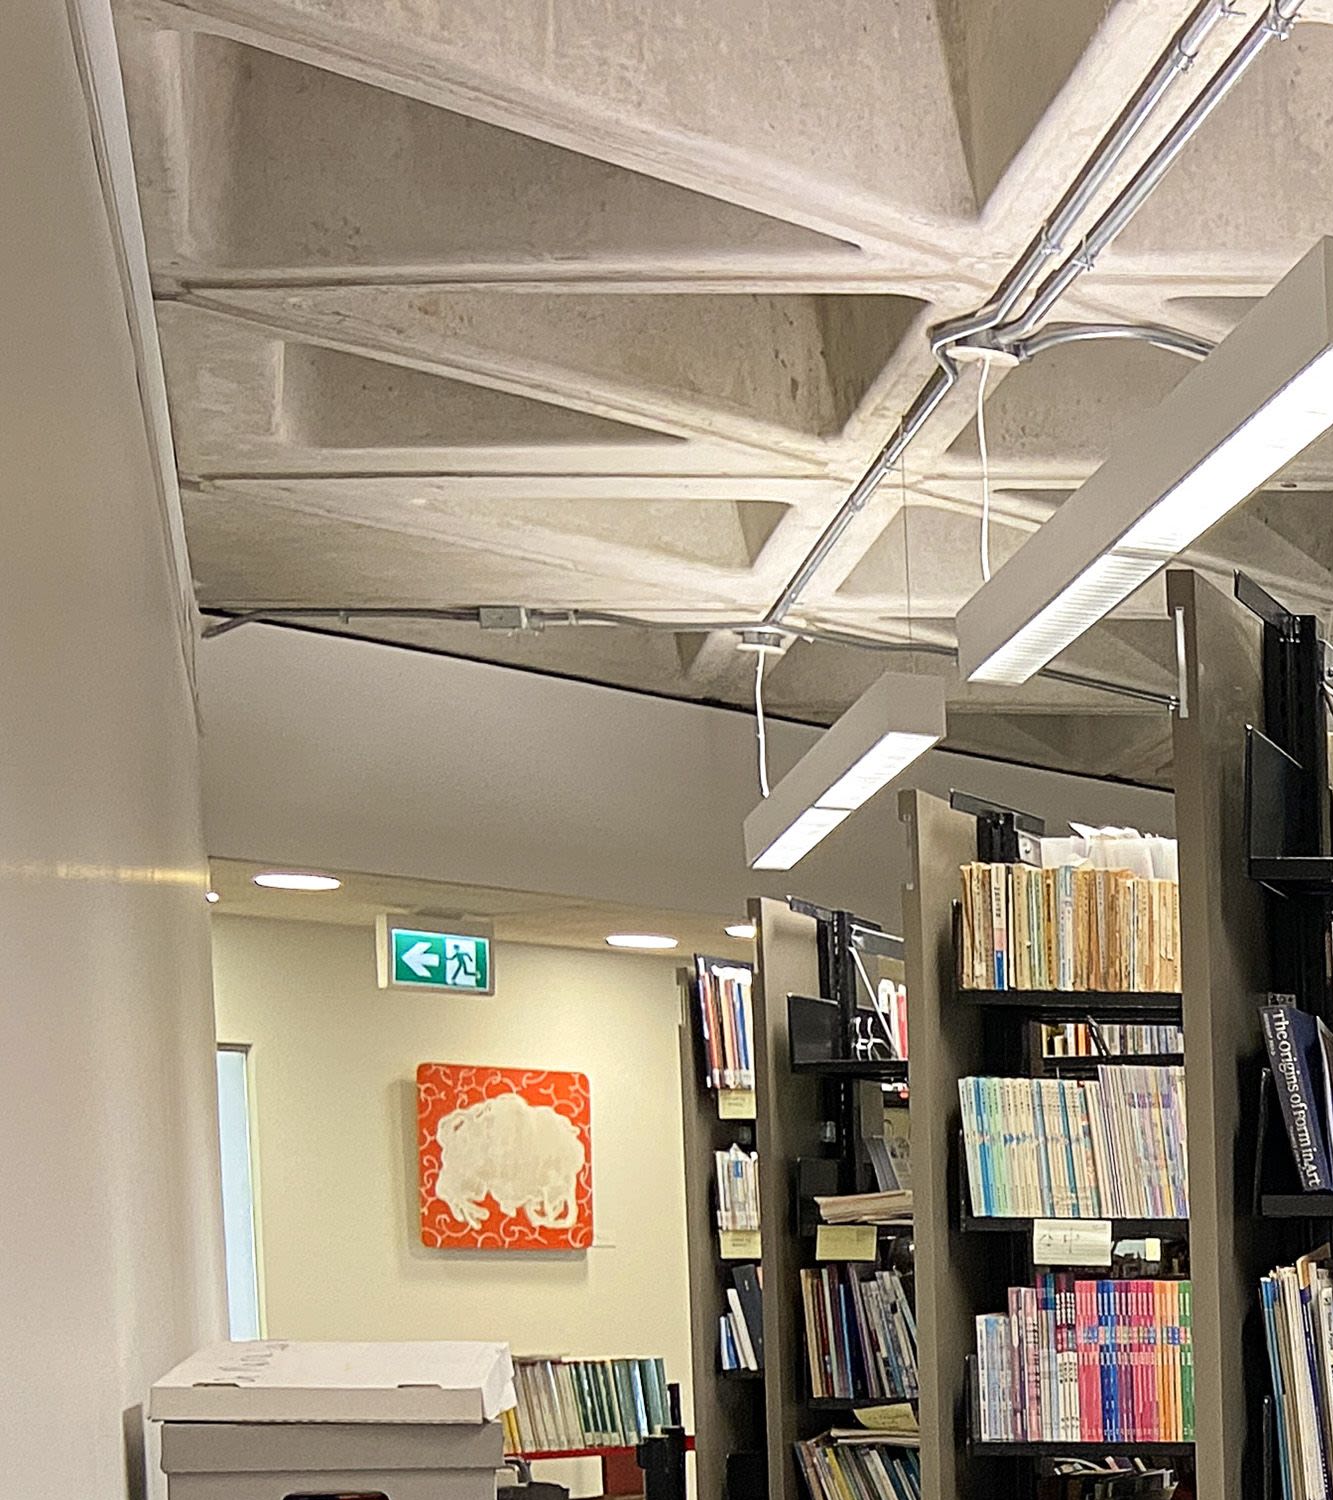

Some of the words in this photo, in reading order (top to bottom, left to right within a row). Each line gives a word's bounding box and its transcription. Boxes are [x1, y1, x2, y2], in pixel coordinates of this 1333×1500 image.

[1273, 1009, 1289, 1040] The
[1289, 1094, 1305, 1110] of
[1303, 1160, 1321, 1187] Art
